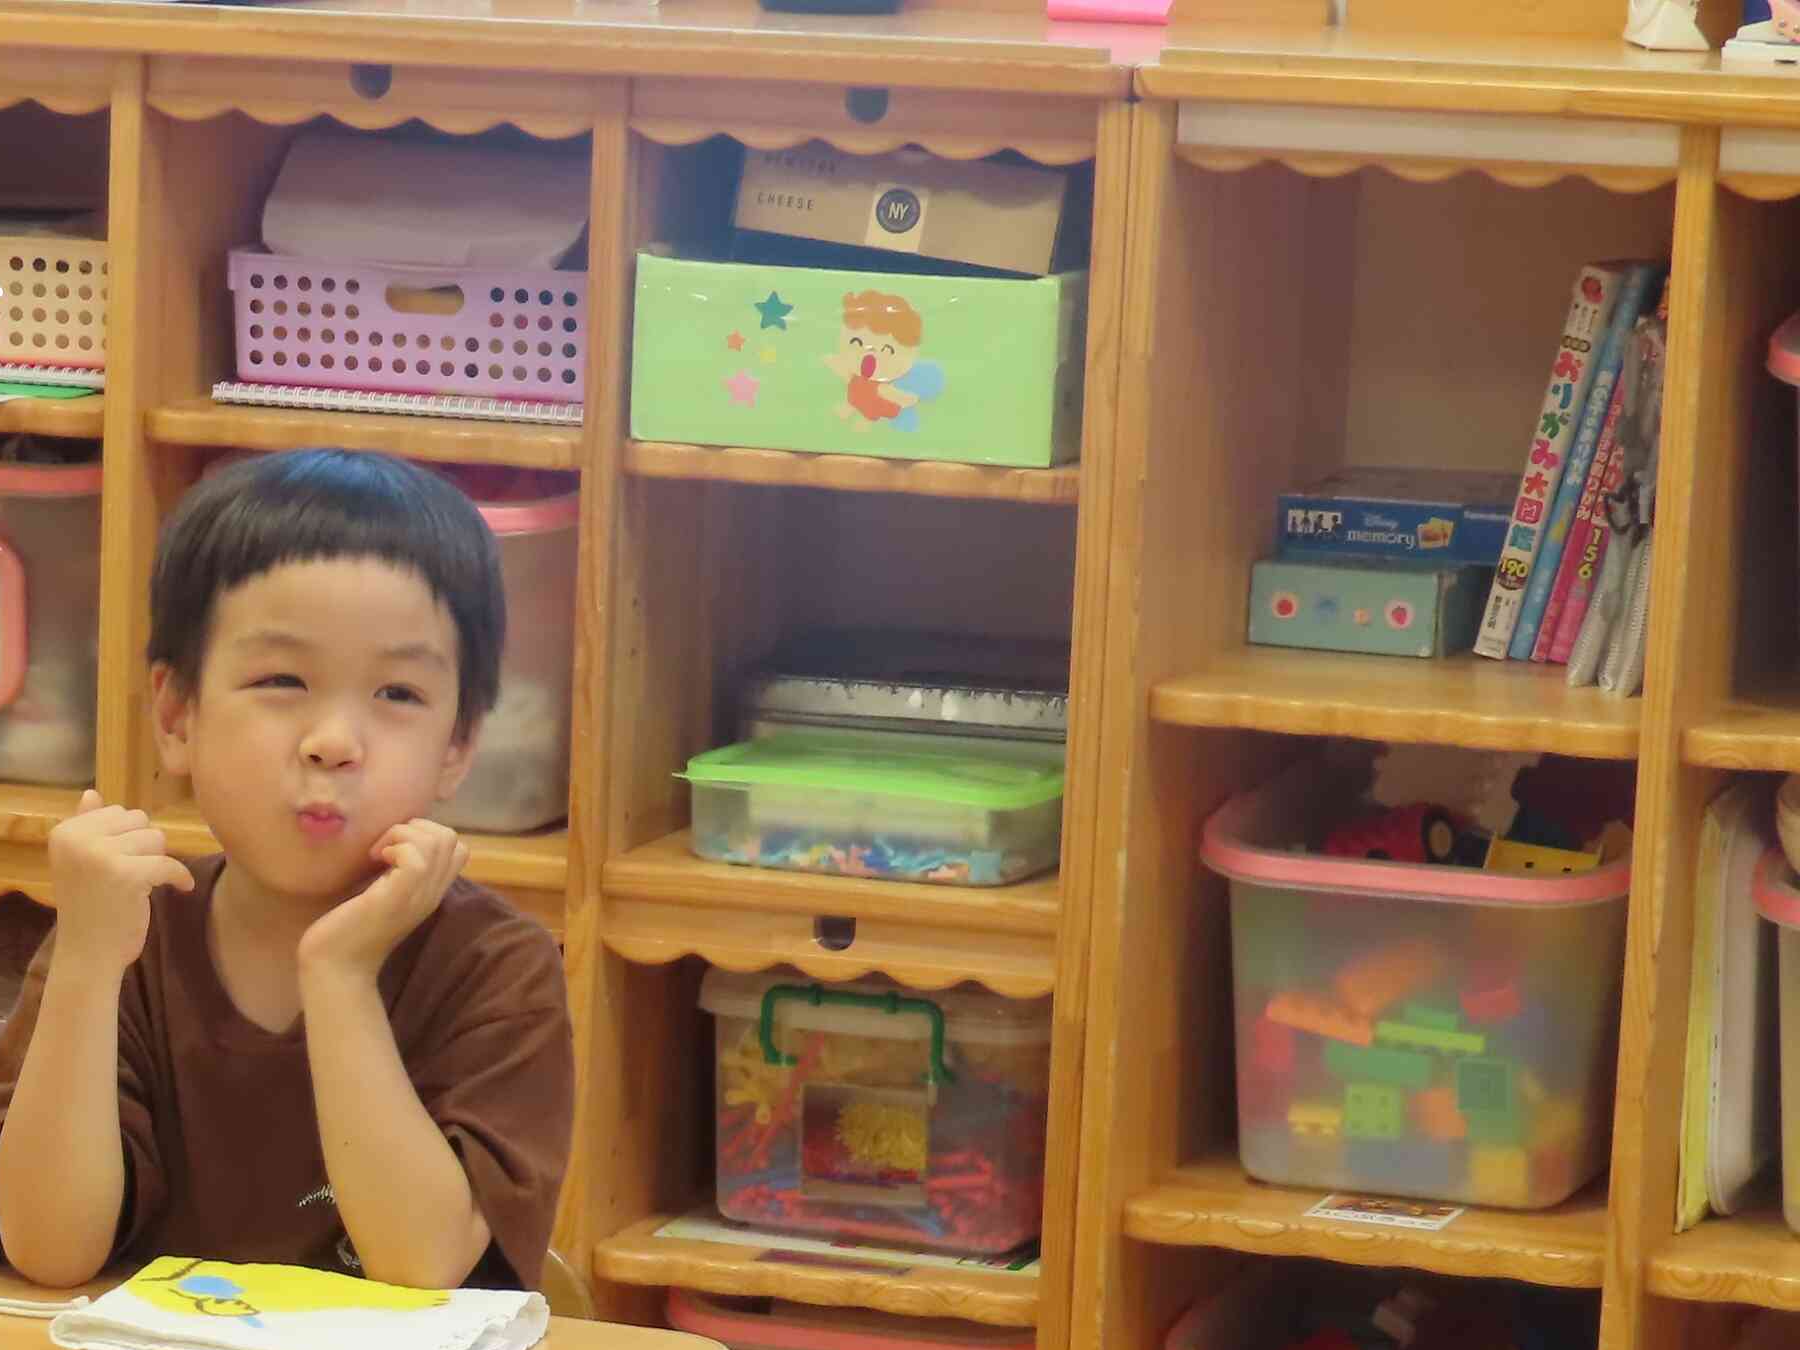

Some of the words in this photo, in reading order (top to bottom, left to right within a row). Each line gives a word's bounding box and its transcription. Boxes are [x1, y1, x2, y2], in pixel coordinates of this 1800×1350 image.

[757, 191, 816, 212] CHEESE
[887, 201, 910, 221] NY
[1345, 528, 1416, 549] memory
[1500, 557, 1529, 579] 190
